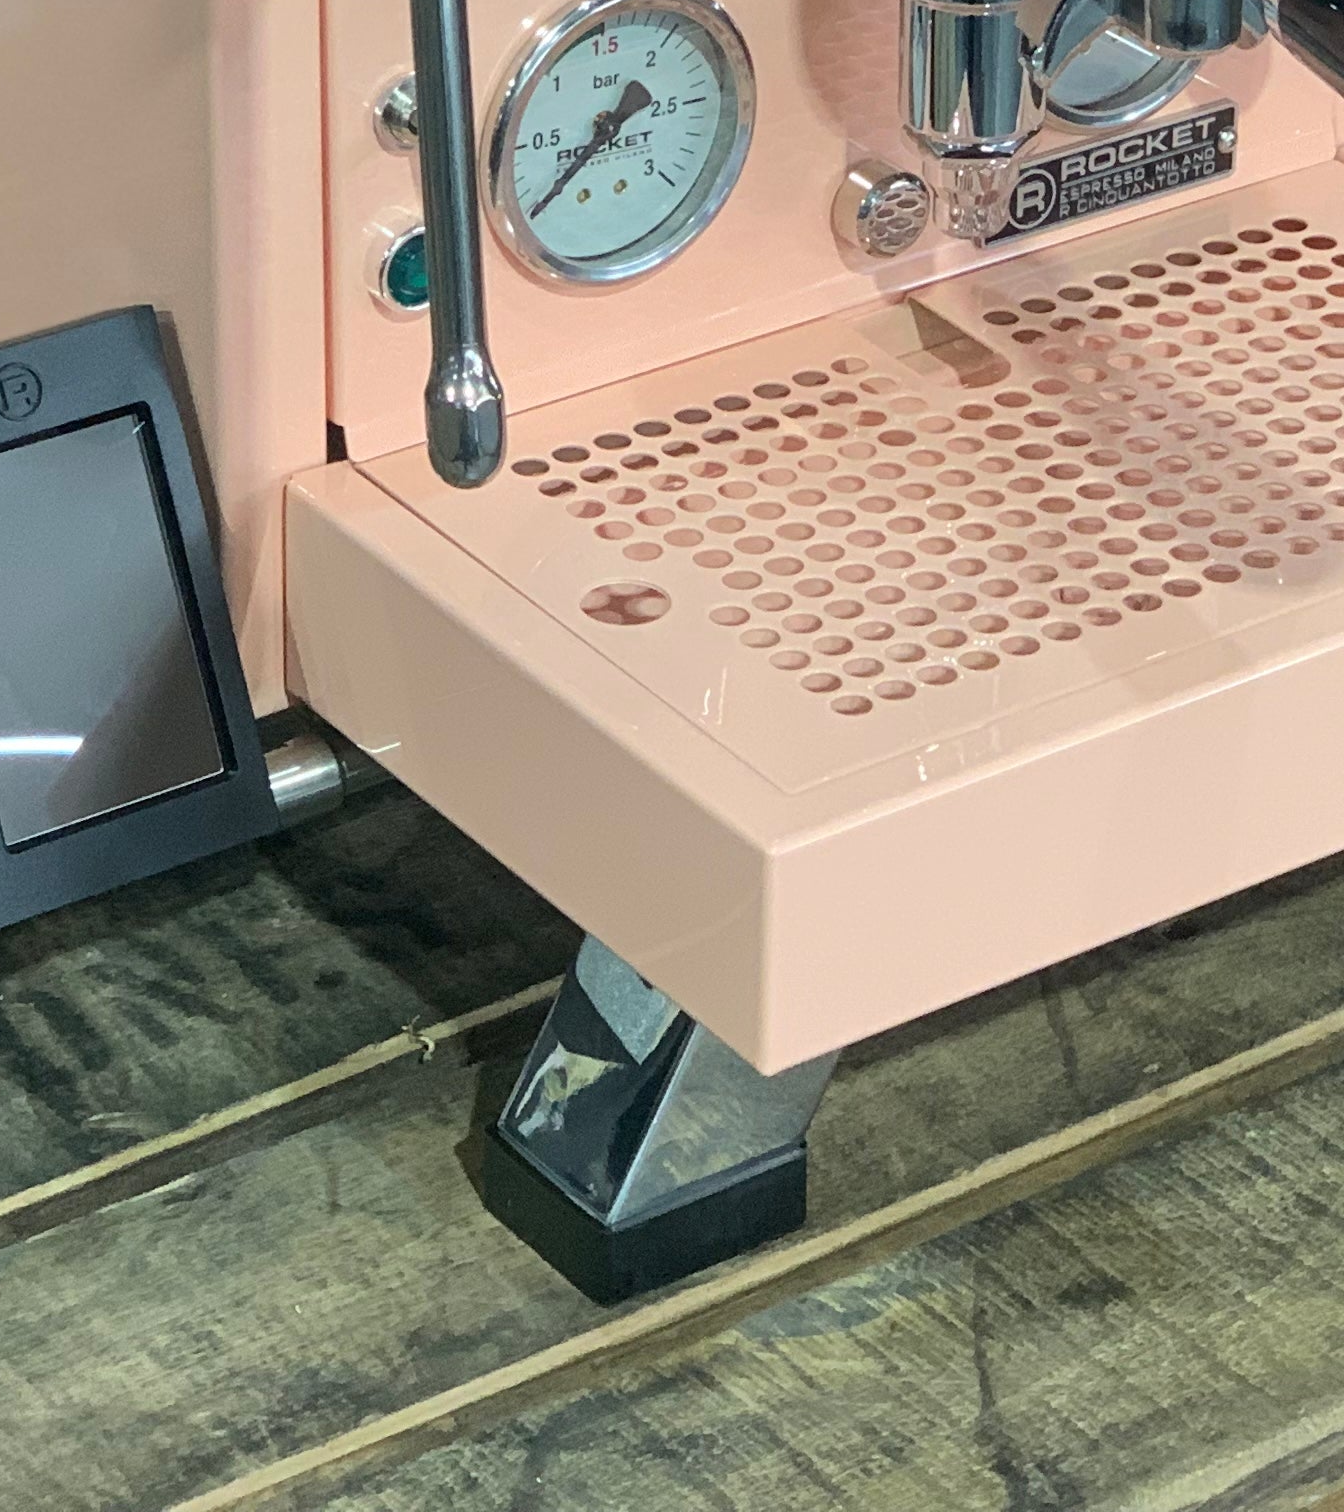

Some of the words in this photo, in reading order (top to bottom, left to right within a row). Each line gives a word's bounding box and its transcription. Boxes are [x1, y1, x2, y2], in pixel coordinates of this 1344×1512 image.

[591, 36, 619, 57] 1.5
[645, 50, 657, 68] 2
[552, 76, 560, 92] 1
[592, 72, 621, 90] bar
[650, 96, 678, 118] 2.5
[532, 128, 561, 150] 0.5
[1060, 116, 1217, 182] ROCKET
[643, 158, 655, 176] 3
[1059, 167, 1146, 204] ESPRESSO
[1155, 147, 1216, 173] MILANO
[1059, 204, 1071, 219] R
[1076, 160, 1216, 214] CINQUANTOTTO
